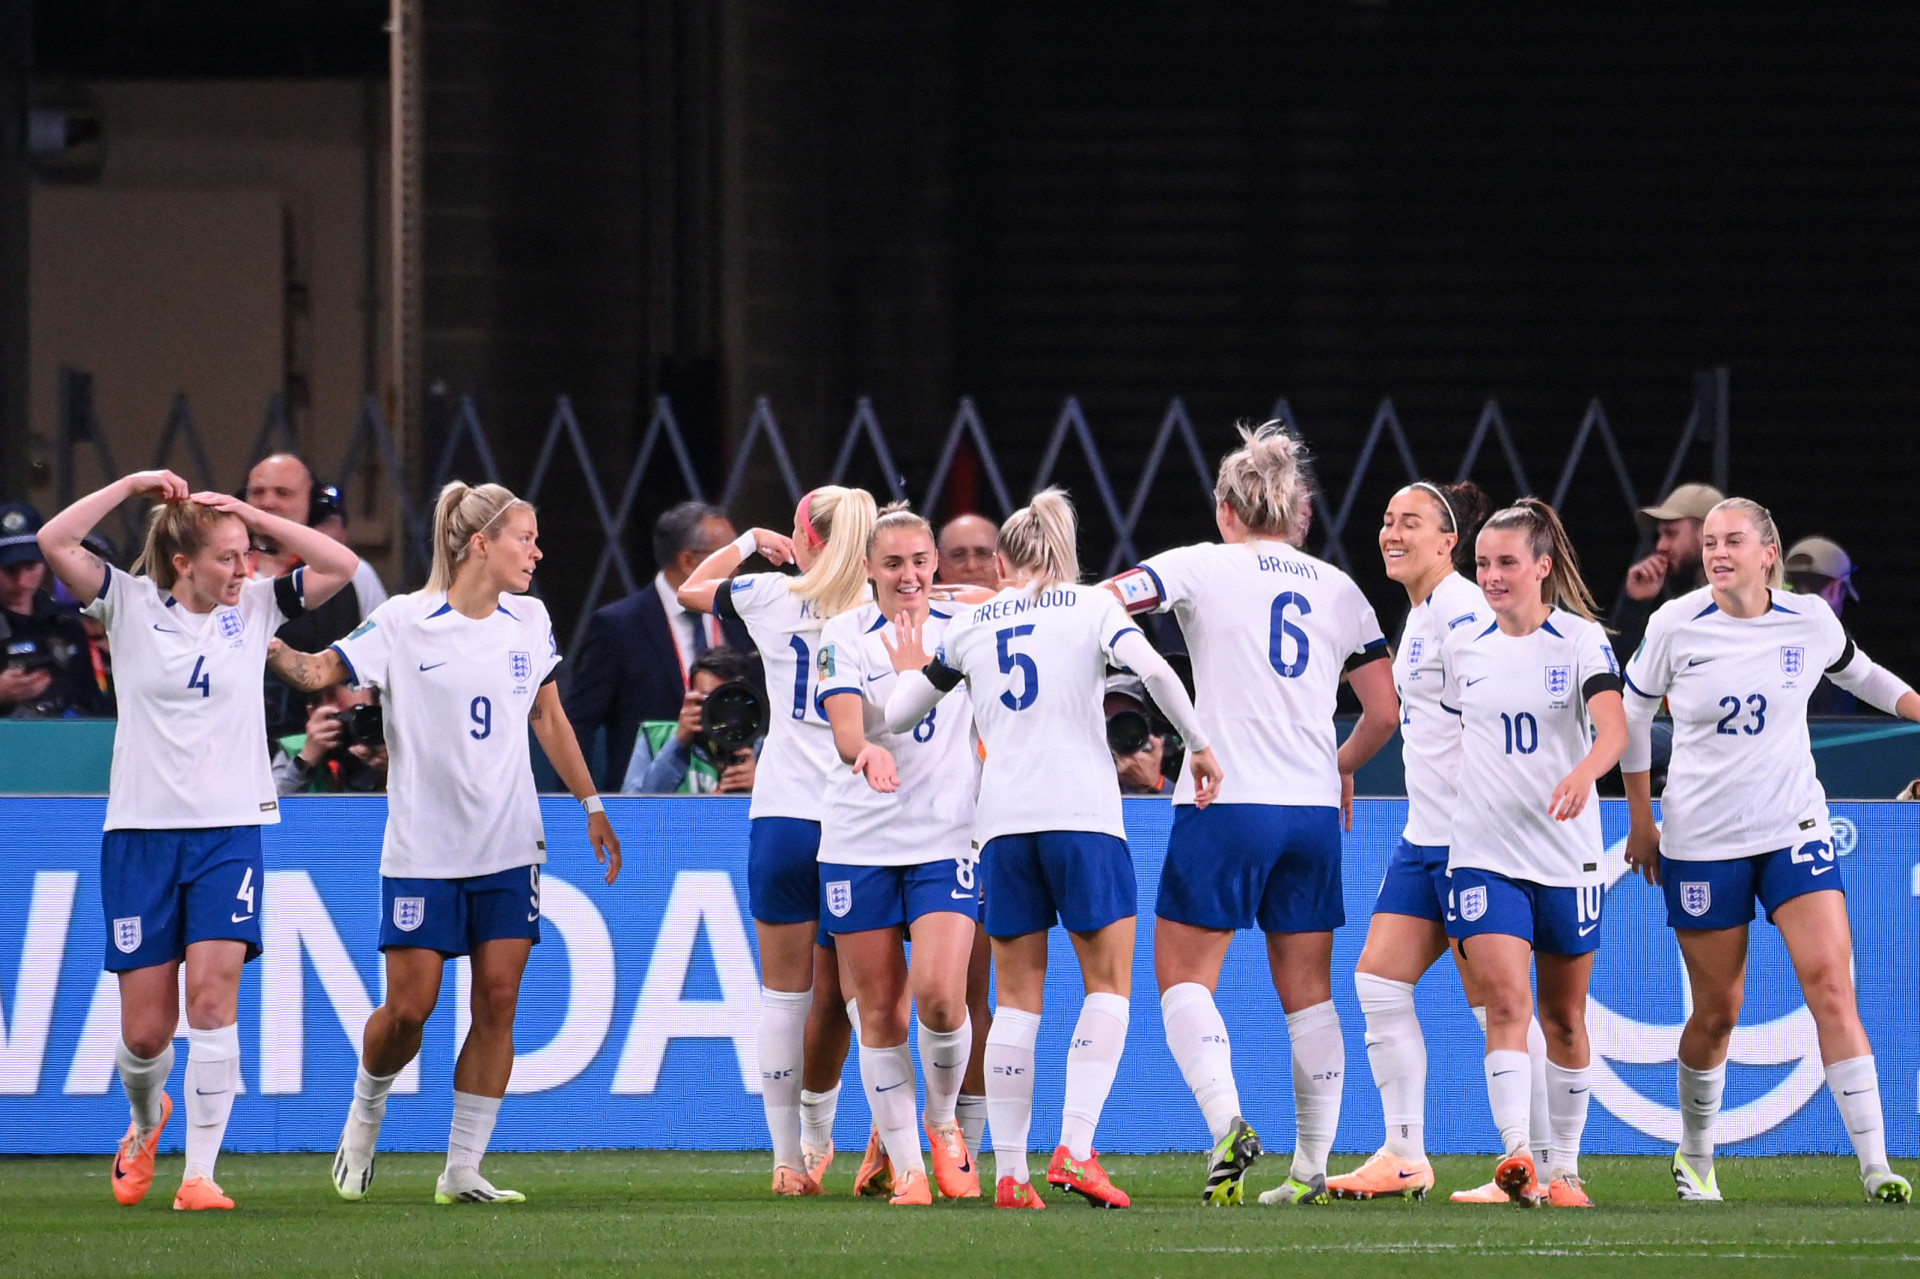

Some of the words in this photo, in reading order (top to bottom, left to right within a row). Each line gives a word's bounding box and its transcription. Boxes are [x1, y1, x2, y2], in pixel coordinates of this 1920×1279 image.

[1257, 555, 1319, 581] BRIGHT
[1269, 591, 1312, 679] 6
[187, 655, 210, 698] 4
[788, 634, 830, 723] 1
[996, 624, 1039, 712] 5
[470, 695, 492, 740] 9
[1500, 711, 1538, 755] 10
[1716, 693, 1767, 736] 23
[236, 866, 255, 914] 4
[954, 858, 975, 890] 8
[1576, 886, 1601, 923] 10
